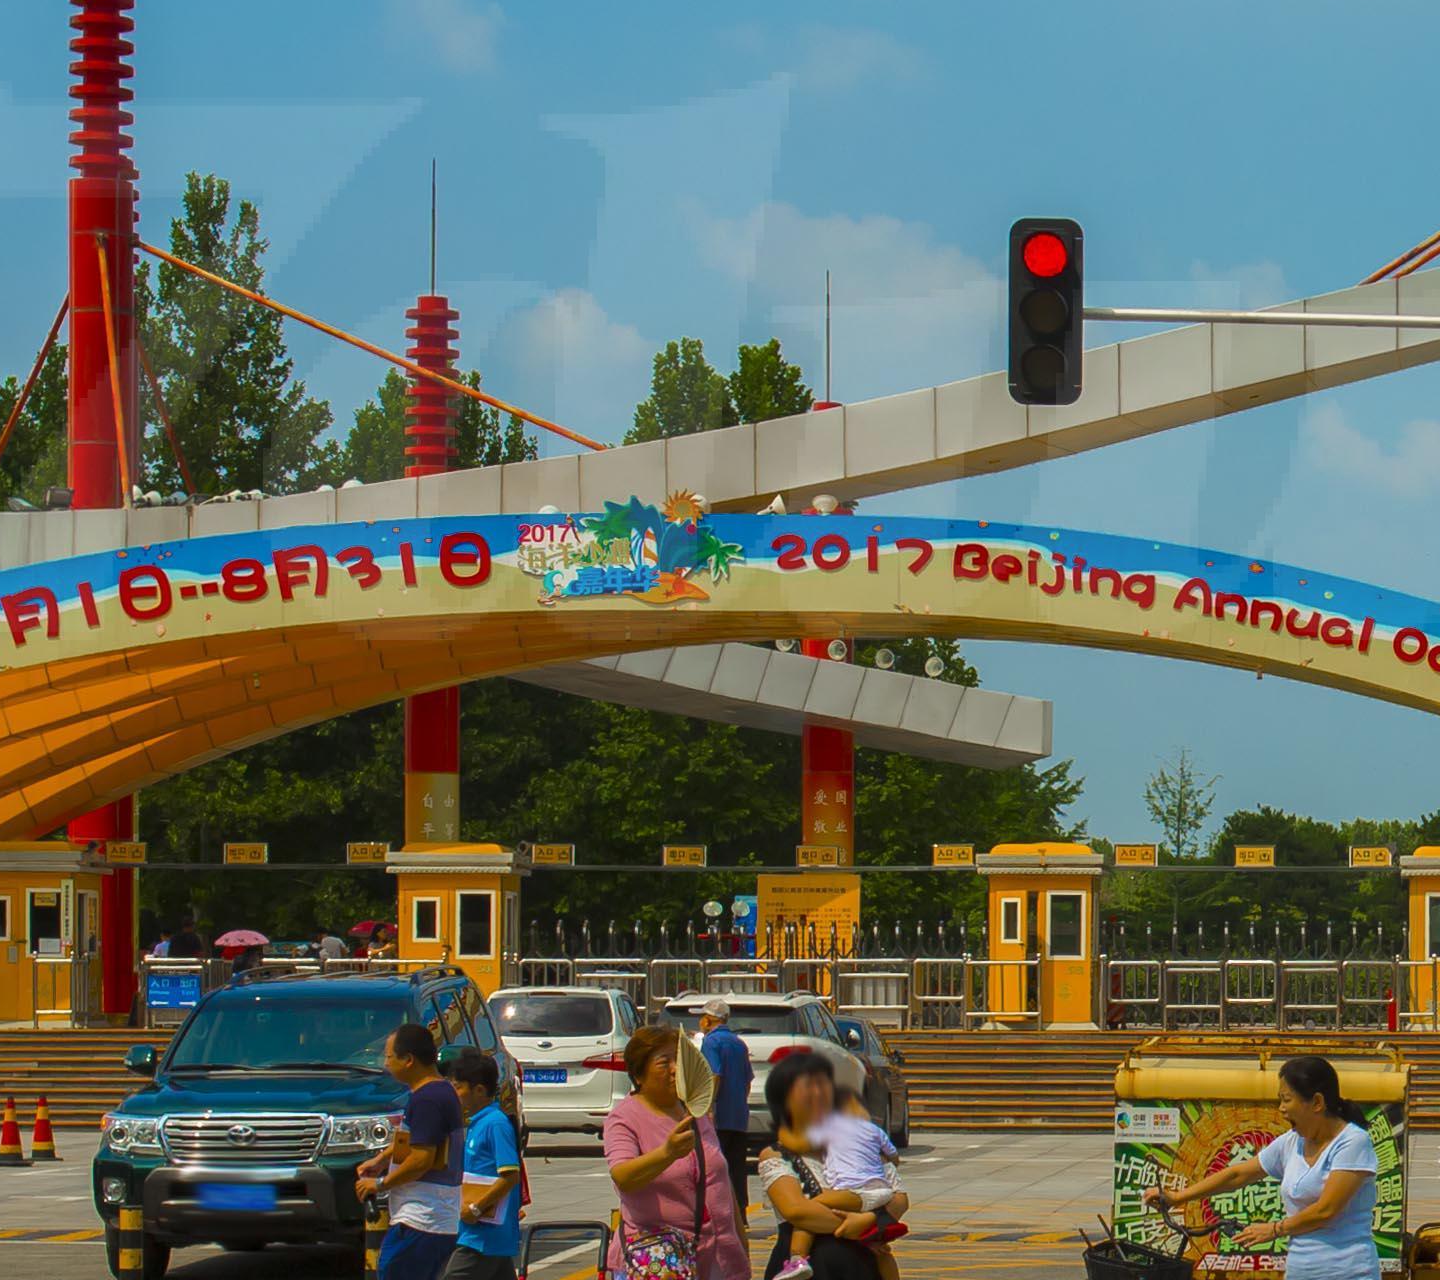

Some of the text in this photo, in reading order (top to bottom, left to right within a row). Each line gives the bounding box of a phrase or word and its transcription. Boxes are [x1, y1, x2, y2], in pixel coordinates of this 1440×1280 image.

[518, 523, 571, 543] 2017
[568, 565, 661, 595] 嘉年华
[769, 531, 935, 578] 2017
[952, 540, 1158, 611] Beijing
[1172, 576, 1378, 656] Annual
[422, 792, 456, 809] 自由
[812, 788, 848, 807] 爱国
[812, 819, 848, 834] 敬业
[150, 977, 170, 988] 入口
